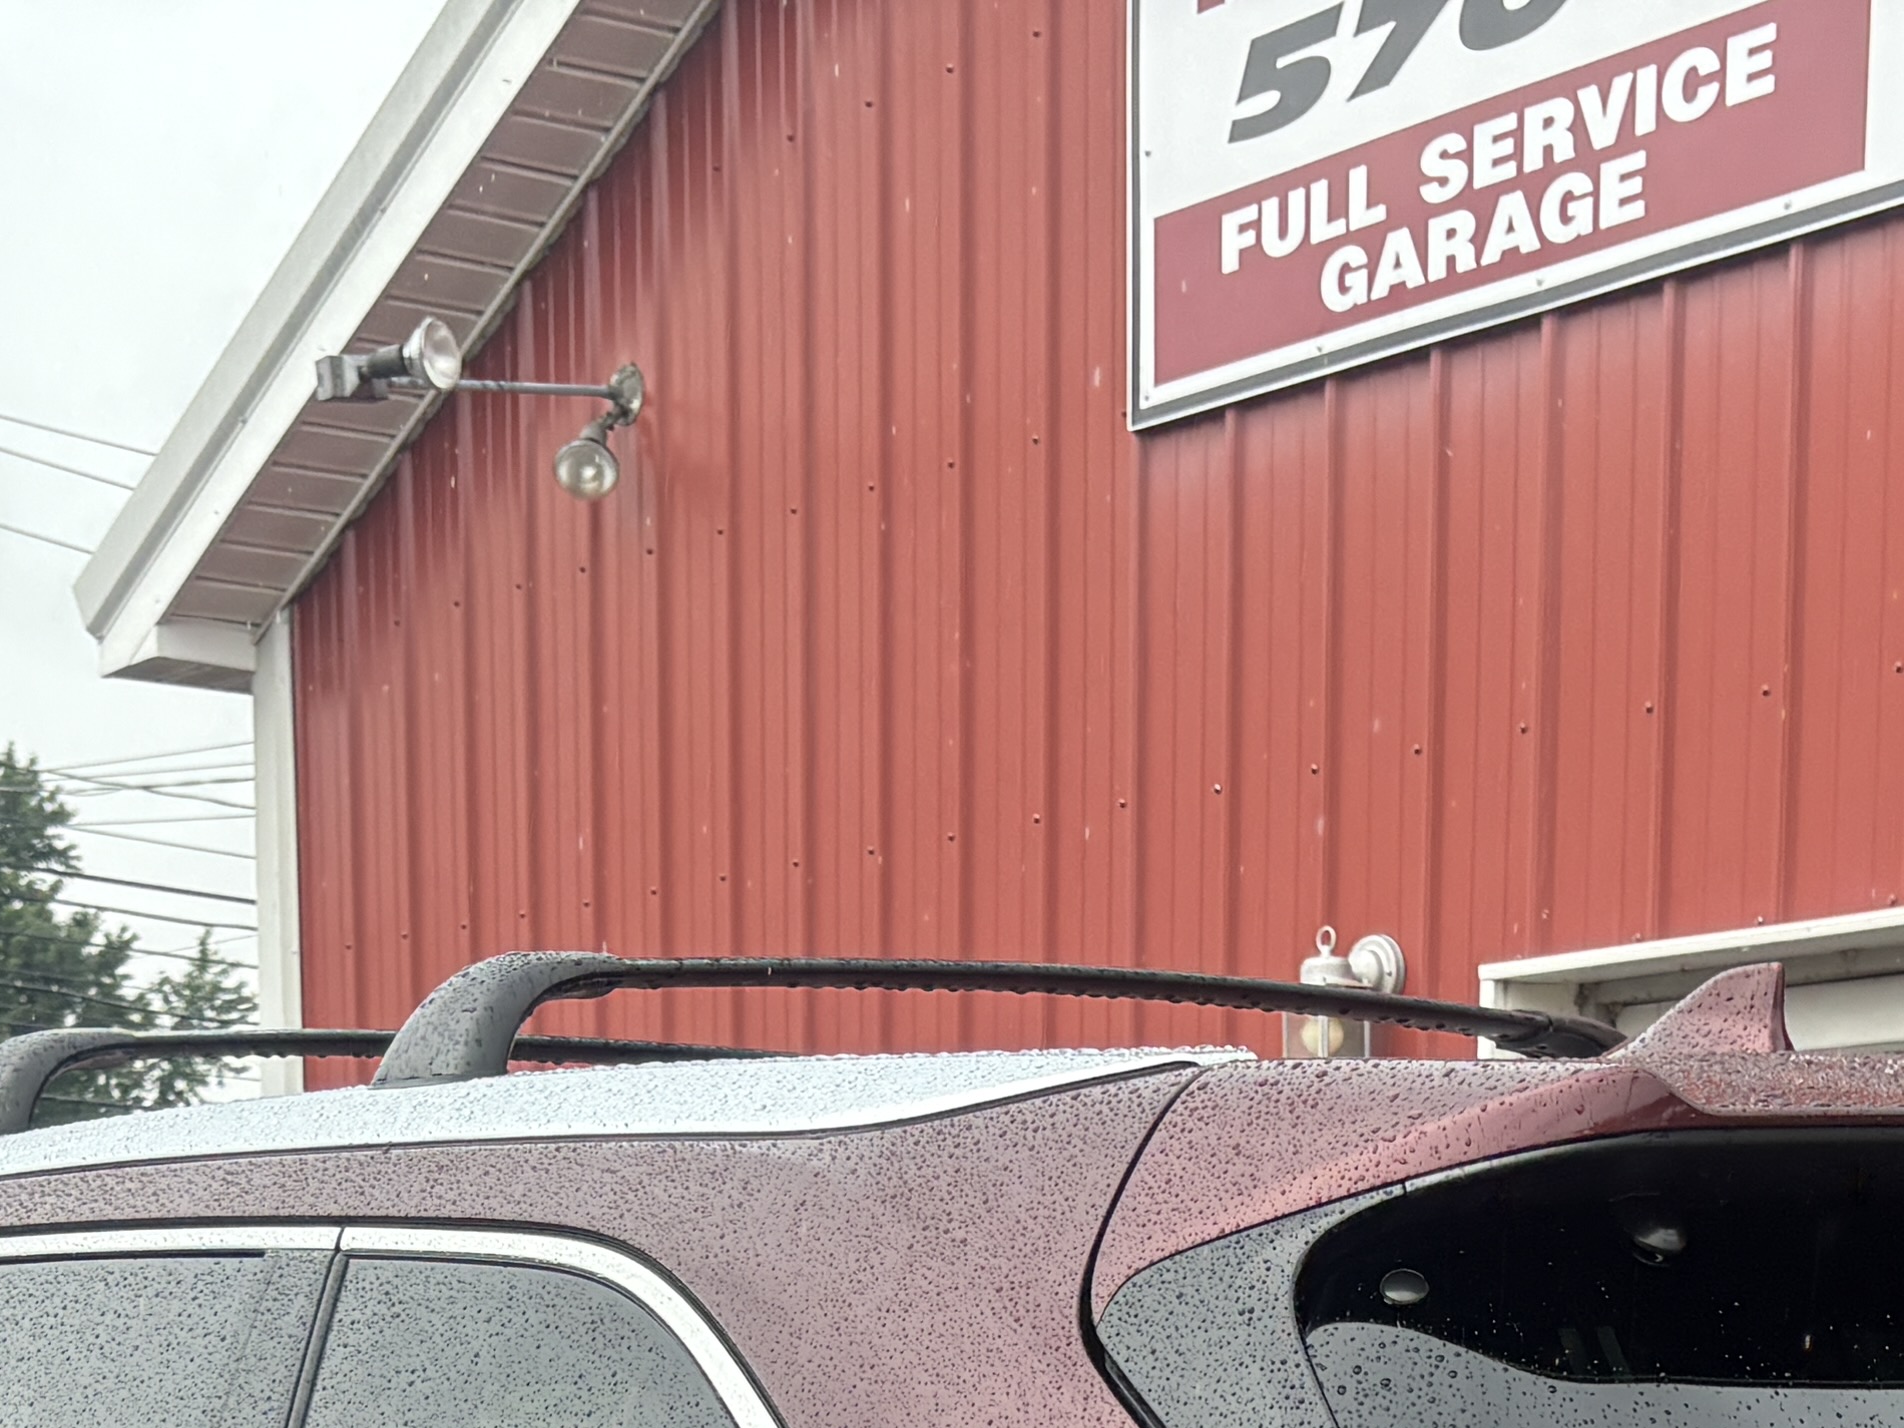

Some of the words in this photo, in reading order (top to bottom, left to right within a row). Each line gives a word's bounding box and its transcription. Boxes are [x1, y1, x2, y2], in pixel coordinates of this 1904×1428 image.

[1221, 164, 1387, 275] FULL
[1419, 22, 1777, 204] SERVICE
[1320, 149, 1647, 313] GARAGE
